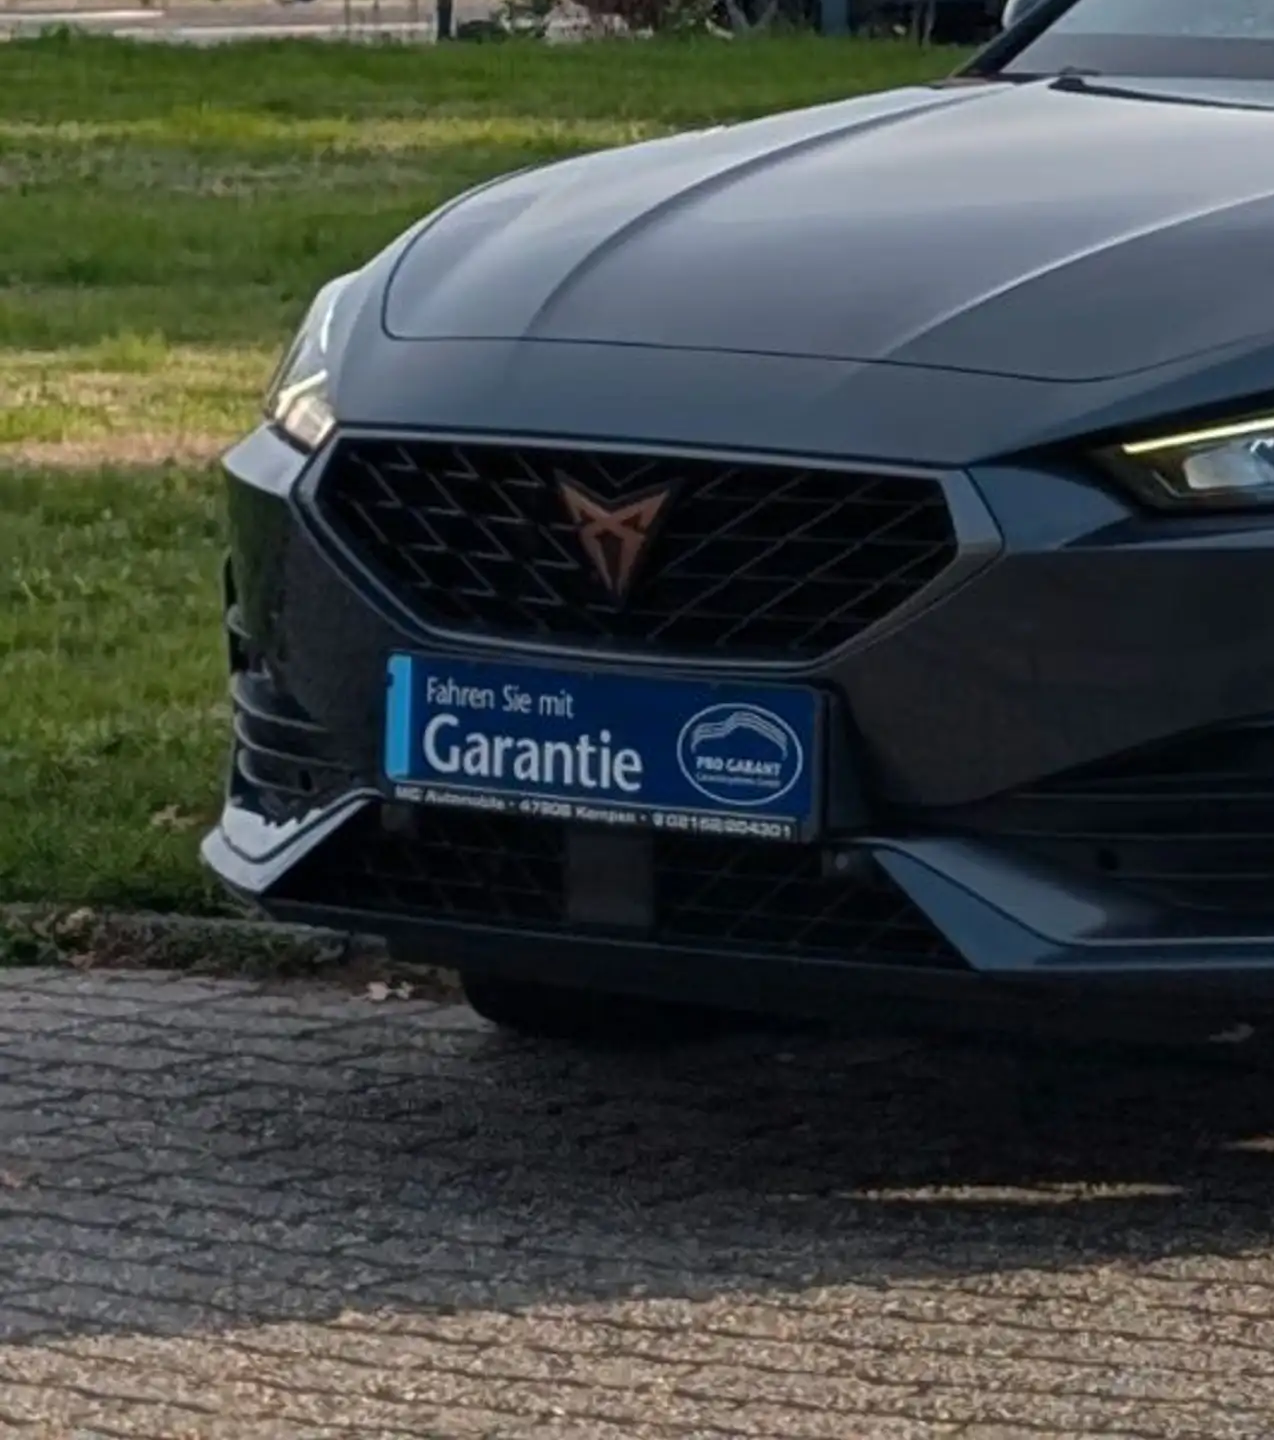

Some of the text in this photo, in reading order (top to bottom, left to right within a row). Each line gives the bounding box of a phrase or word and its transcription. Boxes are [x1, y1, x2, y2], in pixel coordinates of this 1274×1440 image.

[426, 676, 574, 719] Fahren Sie mit
[422, 713, 643, 792] Garantie
